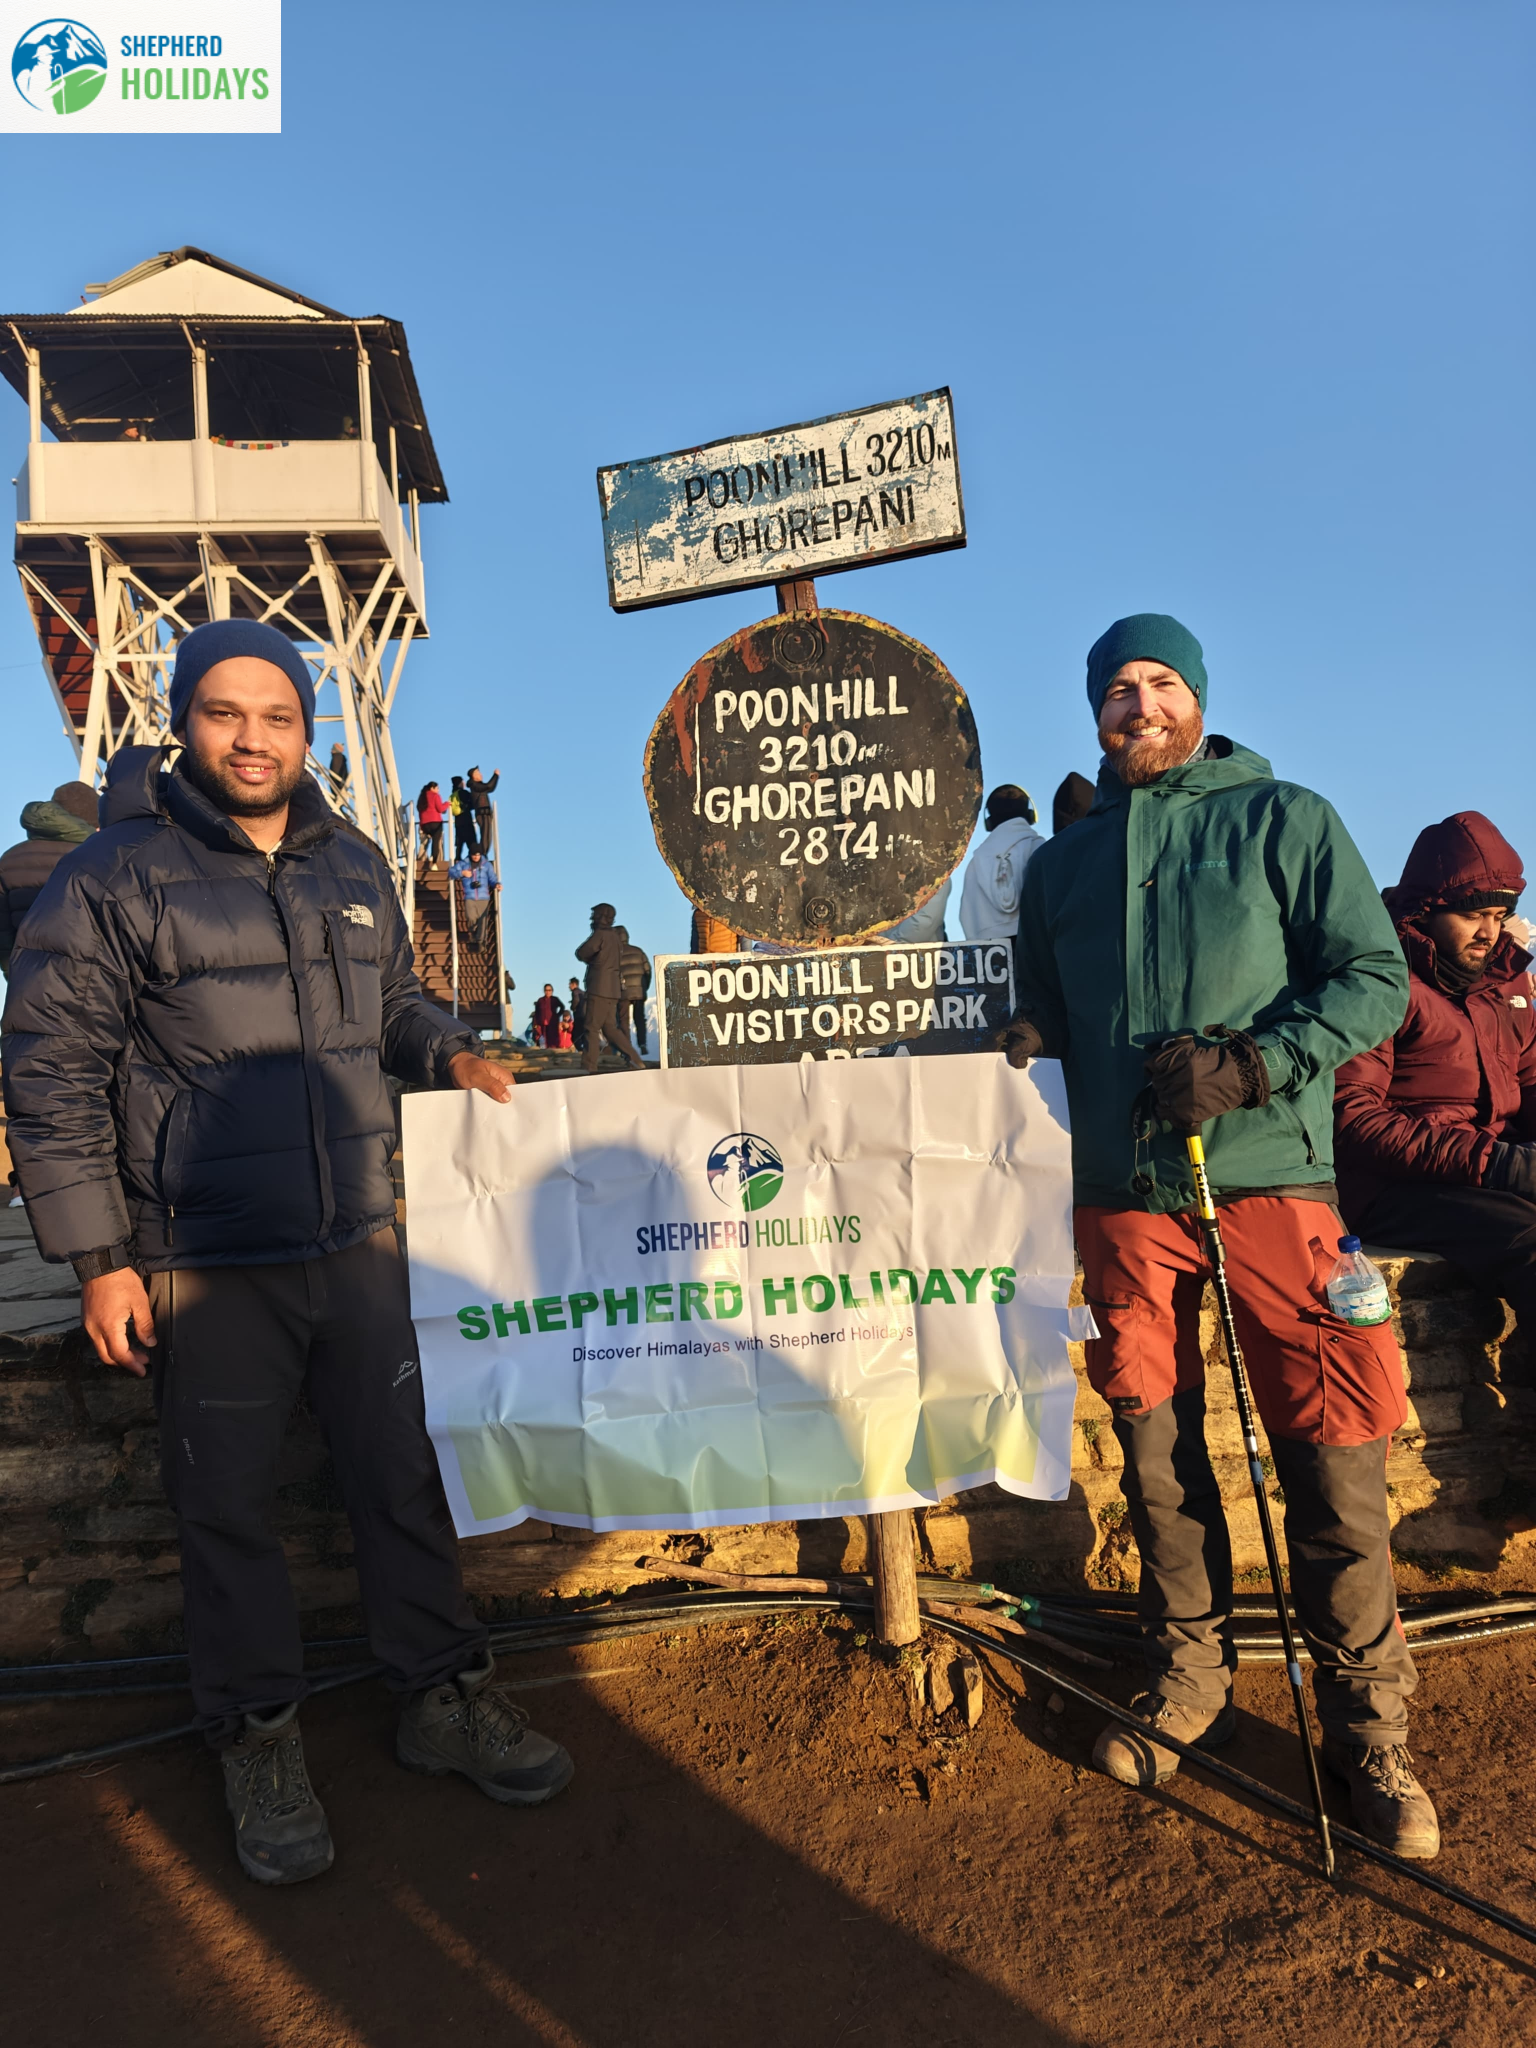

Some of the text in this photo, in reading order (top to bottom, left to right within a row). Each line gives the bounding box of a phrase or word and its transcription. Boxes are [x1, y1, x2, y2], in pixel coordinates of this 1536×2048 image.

[712, 485, 912, 564] GHOREPANI
[704, 768, 936, 830] GHOREPANI
[885, 945, 1007, 991] PUBLIC
[707, 993, 988, 1046] VISITORS PARK
[636, 1215, 862, 1255] SHEPHERD HOLIDAYS
[456, 1266, 1017, 1341] SHEPHERD HOLIDAYS
[572, 1322, 914, 1362] Discover Himalayas with Shepherd Holidays
